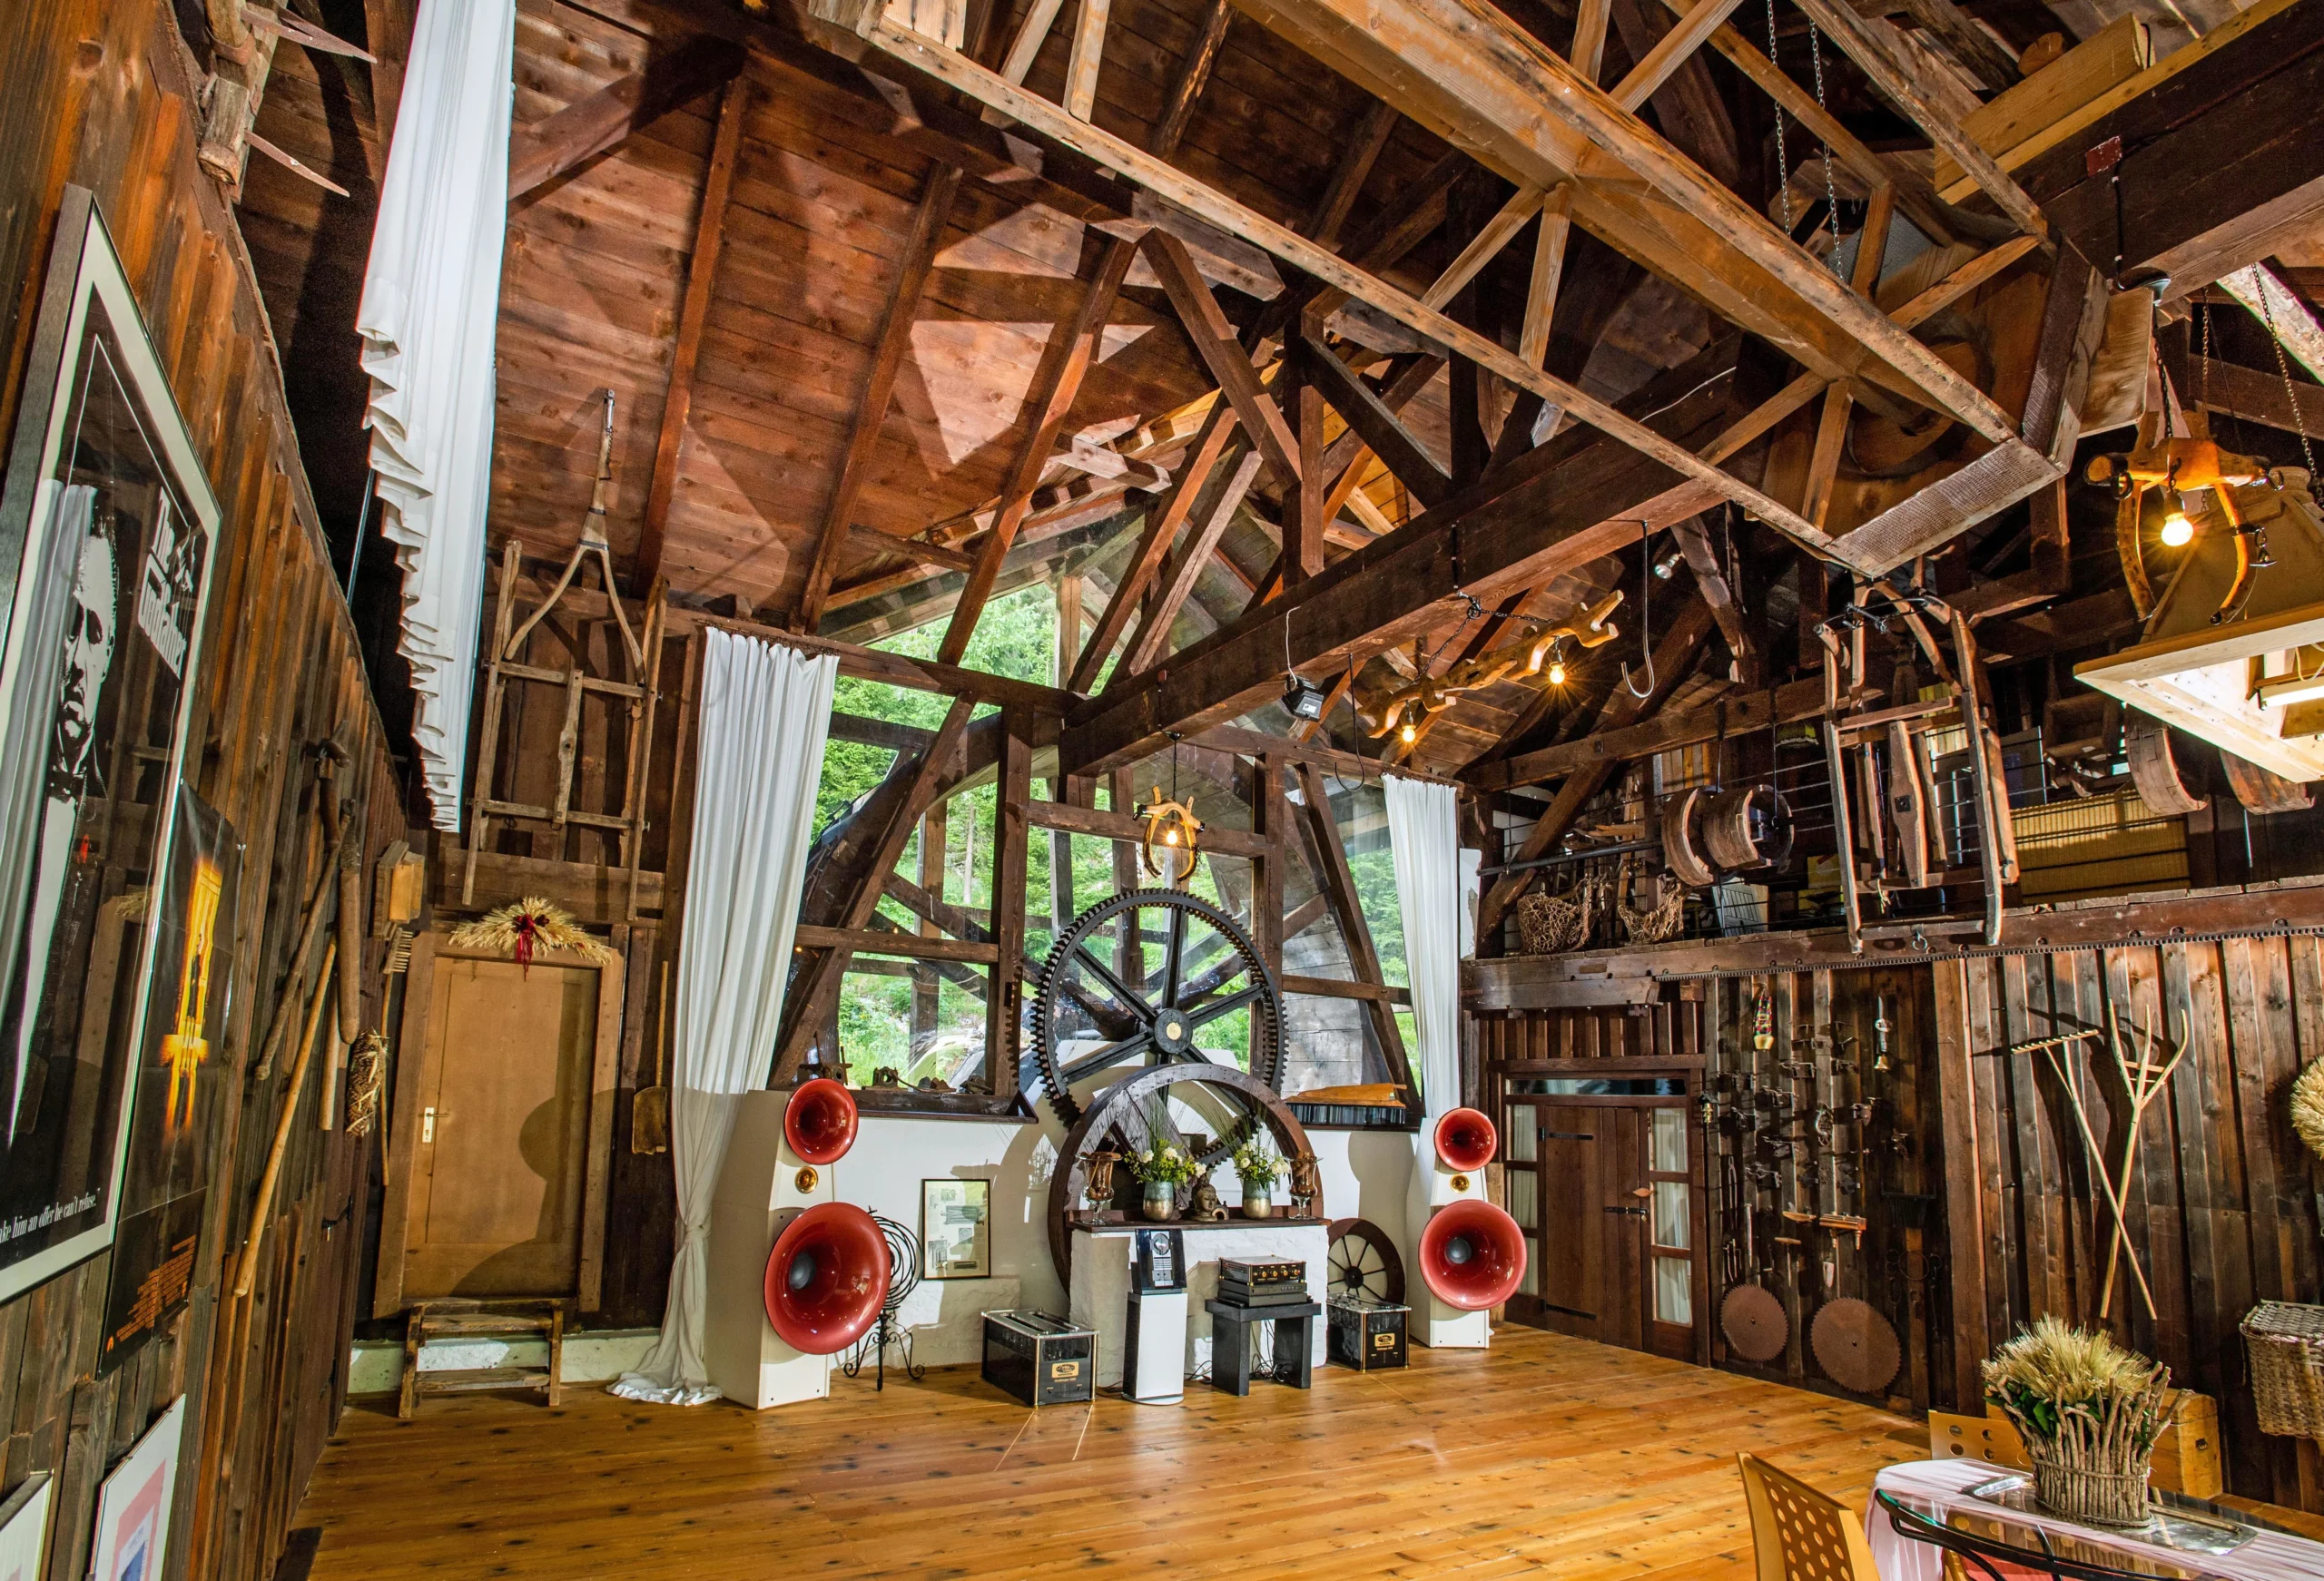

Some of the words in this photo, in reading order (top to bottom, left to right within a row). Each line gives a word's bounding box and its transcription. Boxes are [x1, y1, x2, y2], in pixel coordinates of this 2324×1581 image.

[151, 486, 175, 574] The
[137, 553, 187, 681] Godfather
[12, 1215, 28, 1239] him
[27, 1216, 38, 1232] an
[38, 1205, 54, 1228] offer
[54, 1202, 63, 1223] he
[64, 1195, 78, 1218] can't
